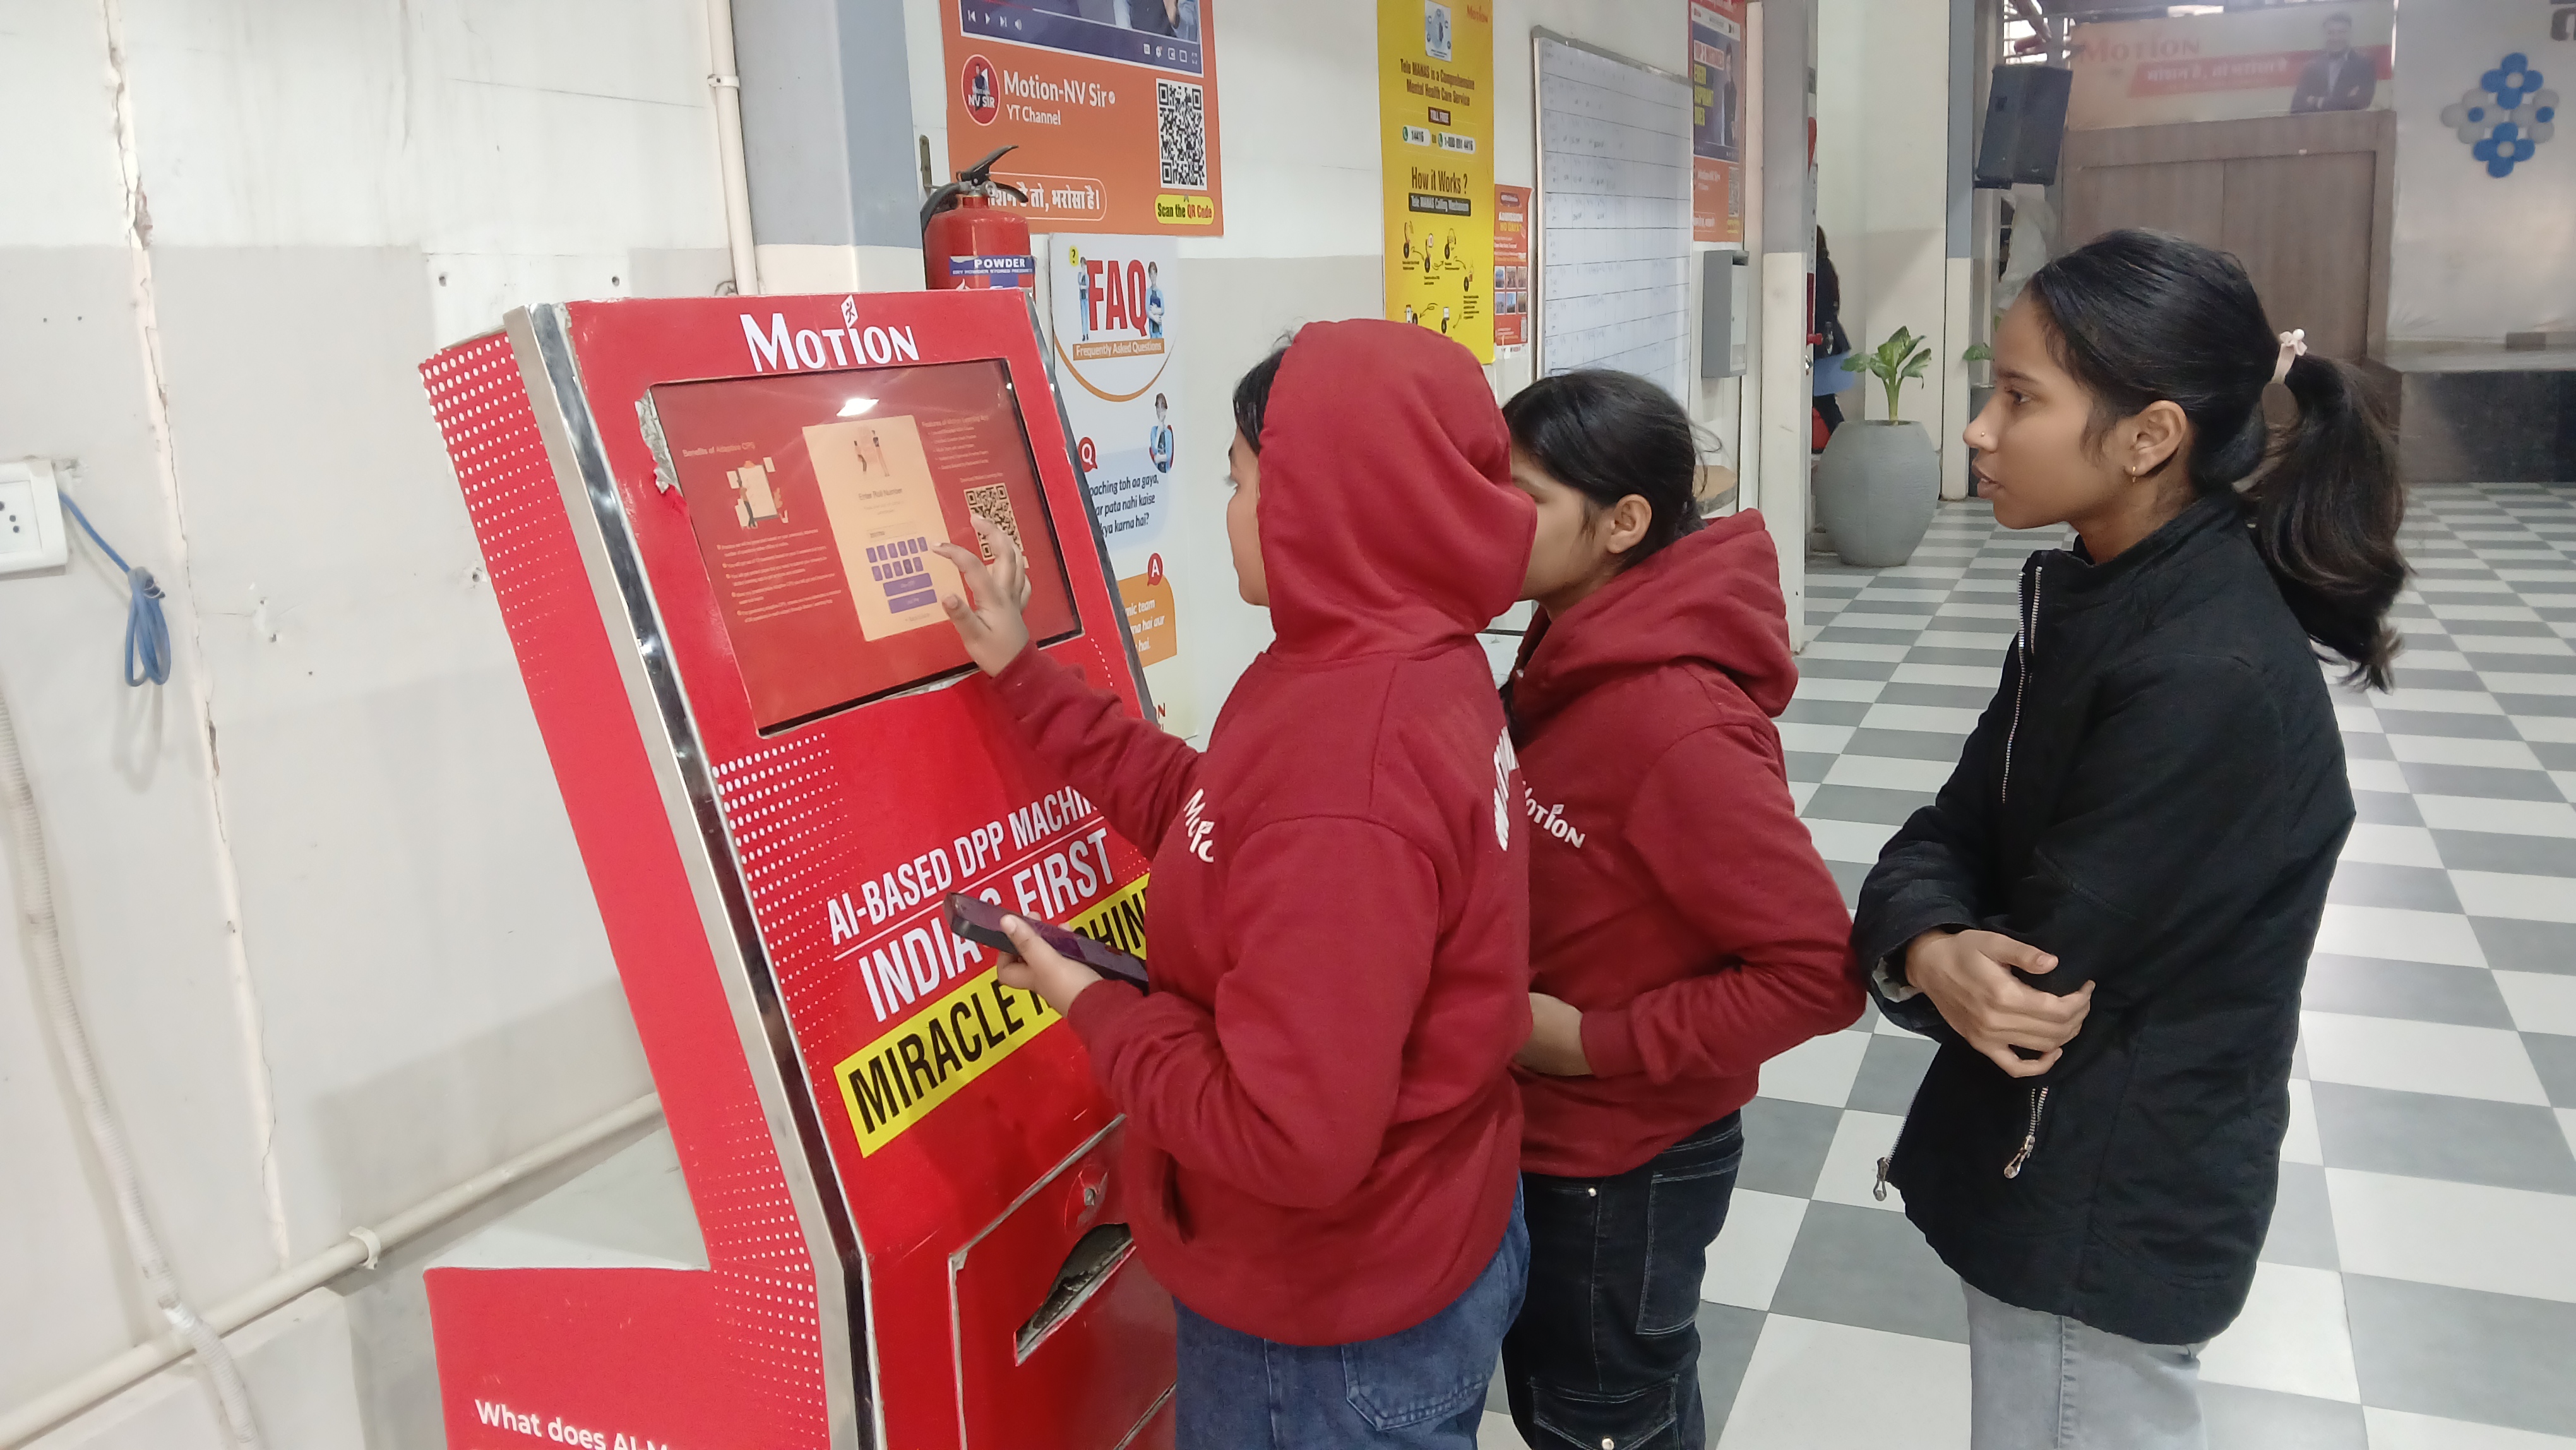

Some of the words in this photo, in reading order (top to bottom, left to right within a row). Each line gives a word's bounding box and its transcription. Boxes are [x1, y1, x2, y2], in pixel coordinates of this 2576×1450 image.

[1003, 69, 1085, 105] Motion-NV
[1089, 83, 1106, 107] Sir
[969, 95, 981, 107] NV
[982, 96, 995, 108] SIR
[1006, 104, 1020, 121] YT
[1022, 106, 1061, 125] Channel
[1412, 166, 1429, 190] How
[1431, 169, 1436, 191] it
[1438, 171, 1461, 194] Works
[1030, 183, 1049, 212] तो,
[1052, 184, 1085, 210] भरोसा
[1158, 203, 1173, 217] Scan
[1175, 203, 1185, 218] the
[1188, 204, 1196, 219] QR
[1197, 205, 1212, 219] Code
[974, 258, 1025, 268] POWDER
[1086, 260, 1147, 337] FAQ
[740, 309, 919, 372] MOTION
[1076, 344, 1112, 357] Frequently
[1112, 342, 1131, 354] Asked
[1133, 341, 1162, 352] Questions
[1082, 443, 1093, 465] Q
[1088, 480, 1118, 496] oaching
[1119, 477, 1131, 491] toh
[1132, 478, 1141, 487] aa
[1142, 474, 1159, 489] gaya,
[1105, 501, 1121, 517] pata
[1123, 495, 1137, 512] nahi
[1139, 493, 1155, 505] kaise
[1114, 518, 1135, 533] karna
[1136, 512, 1150, 527] hai?
[1151, 559, 1160, 577] A
[1138, 599, 1155, 613] team
[1143, 616, 1153, 630] hai
[827, 849, 952, 945] AI-BASED
[954, 821, 1005, 878] DPP
[1012, 828, 1114, 921] FIRST
[848, 979, 1024, 1134] MIRACLE
[474, 1399, 542, 1437] What
[547, 1417, 606, 1450] does
